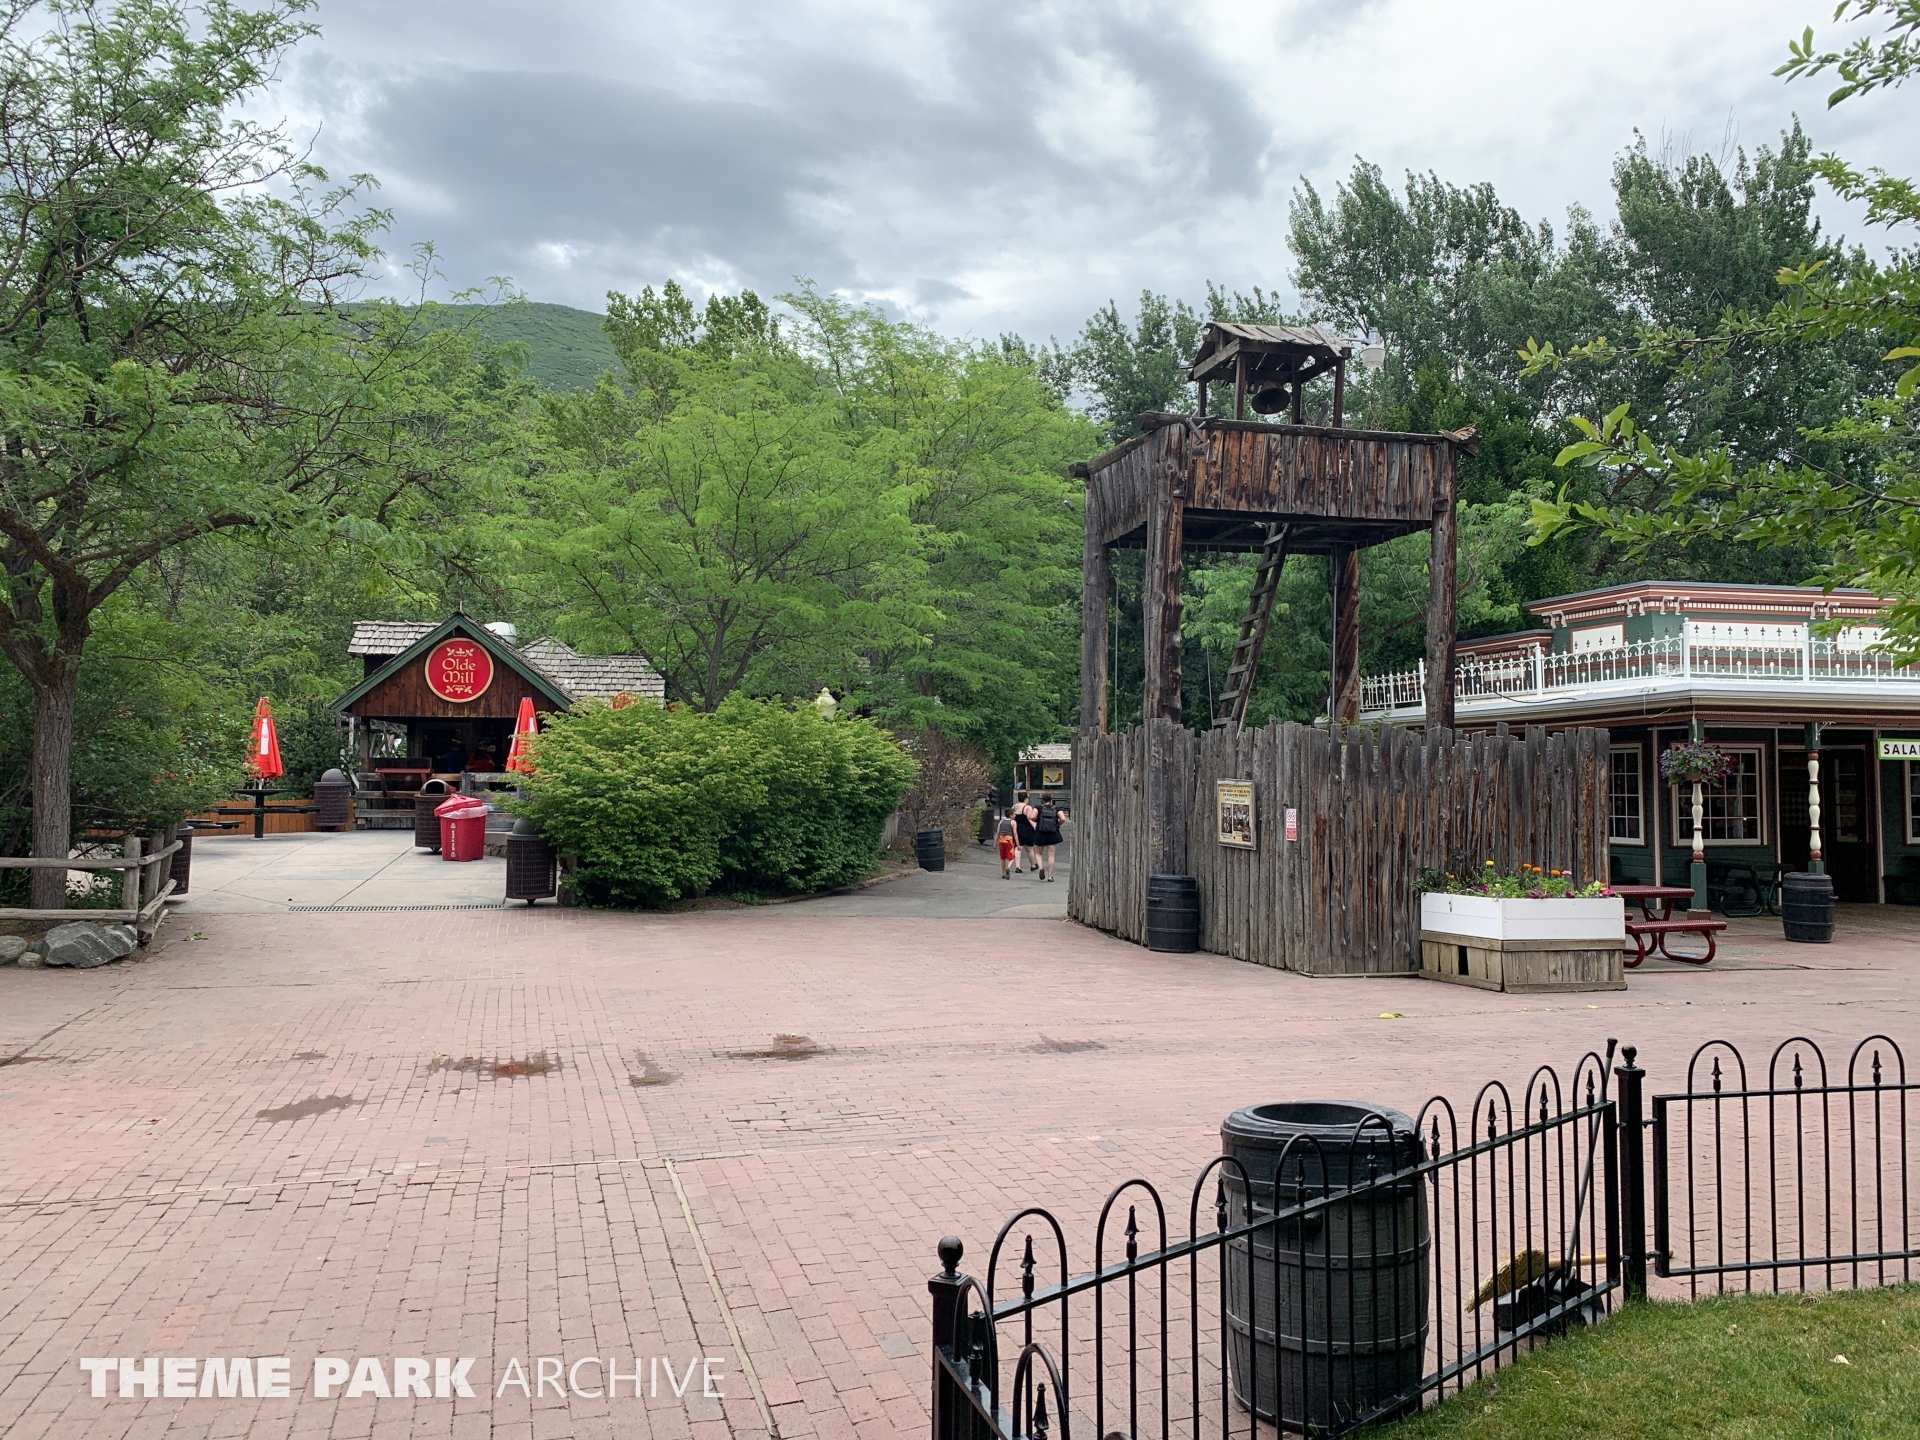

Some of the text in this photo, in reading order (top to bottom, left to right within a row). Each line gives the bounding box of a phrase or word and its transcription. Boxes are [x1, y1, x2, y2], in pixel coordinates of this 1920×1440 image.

[442, 658, 476, 671] Olde
[442, 671, 474, 683] Mill
[1884, 744, 1920, 755] SALA
